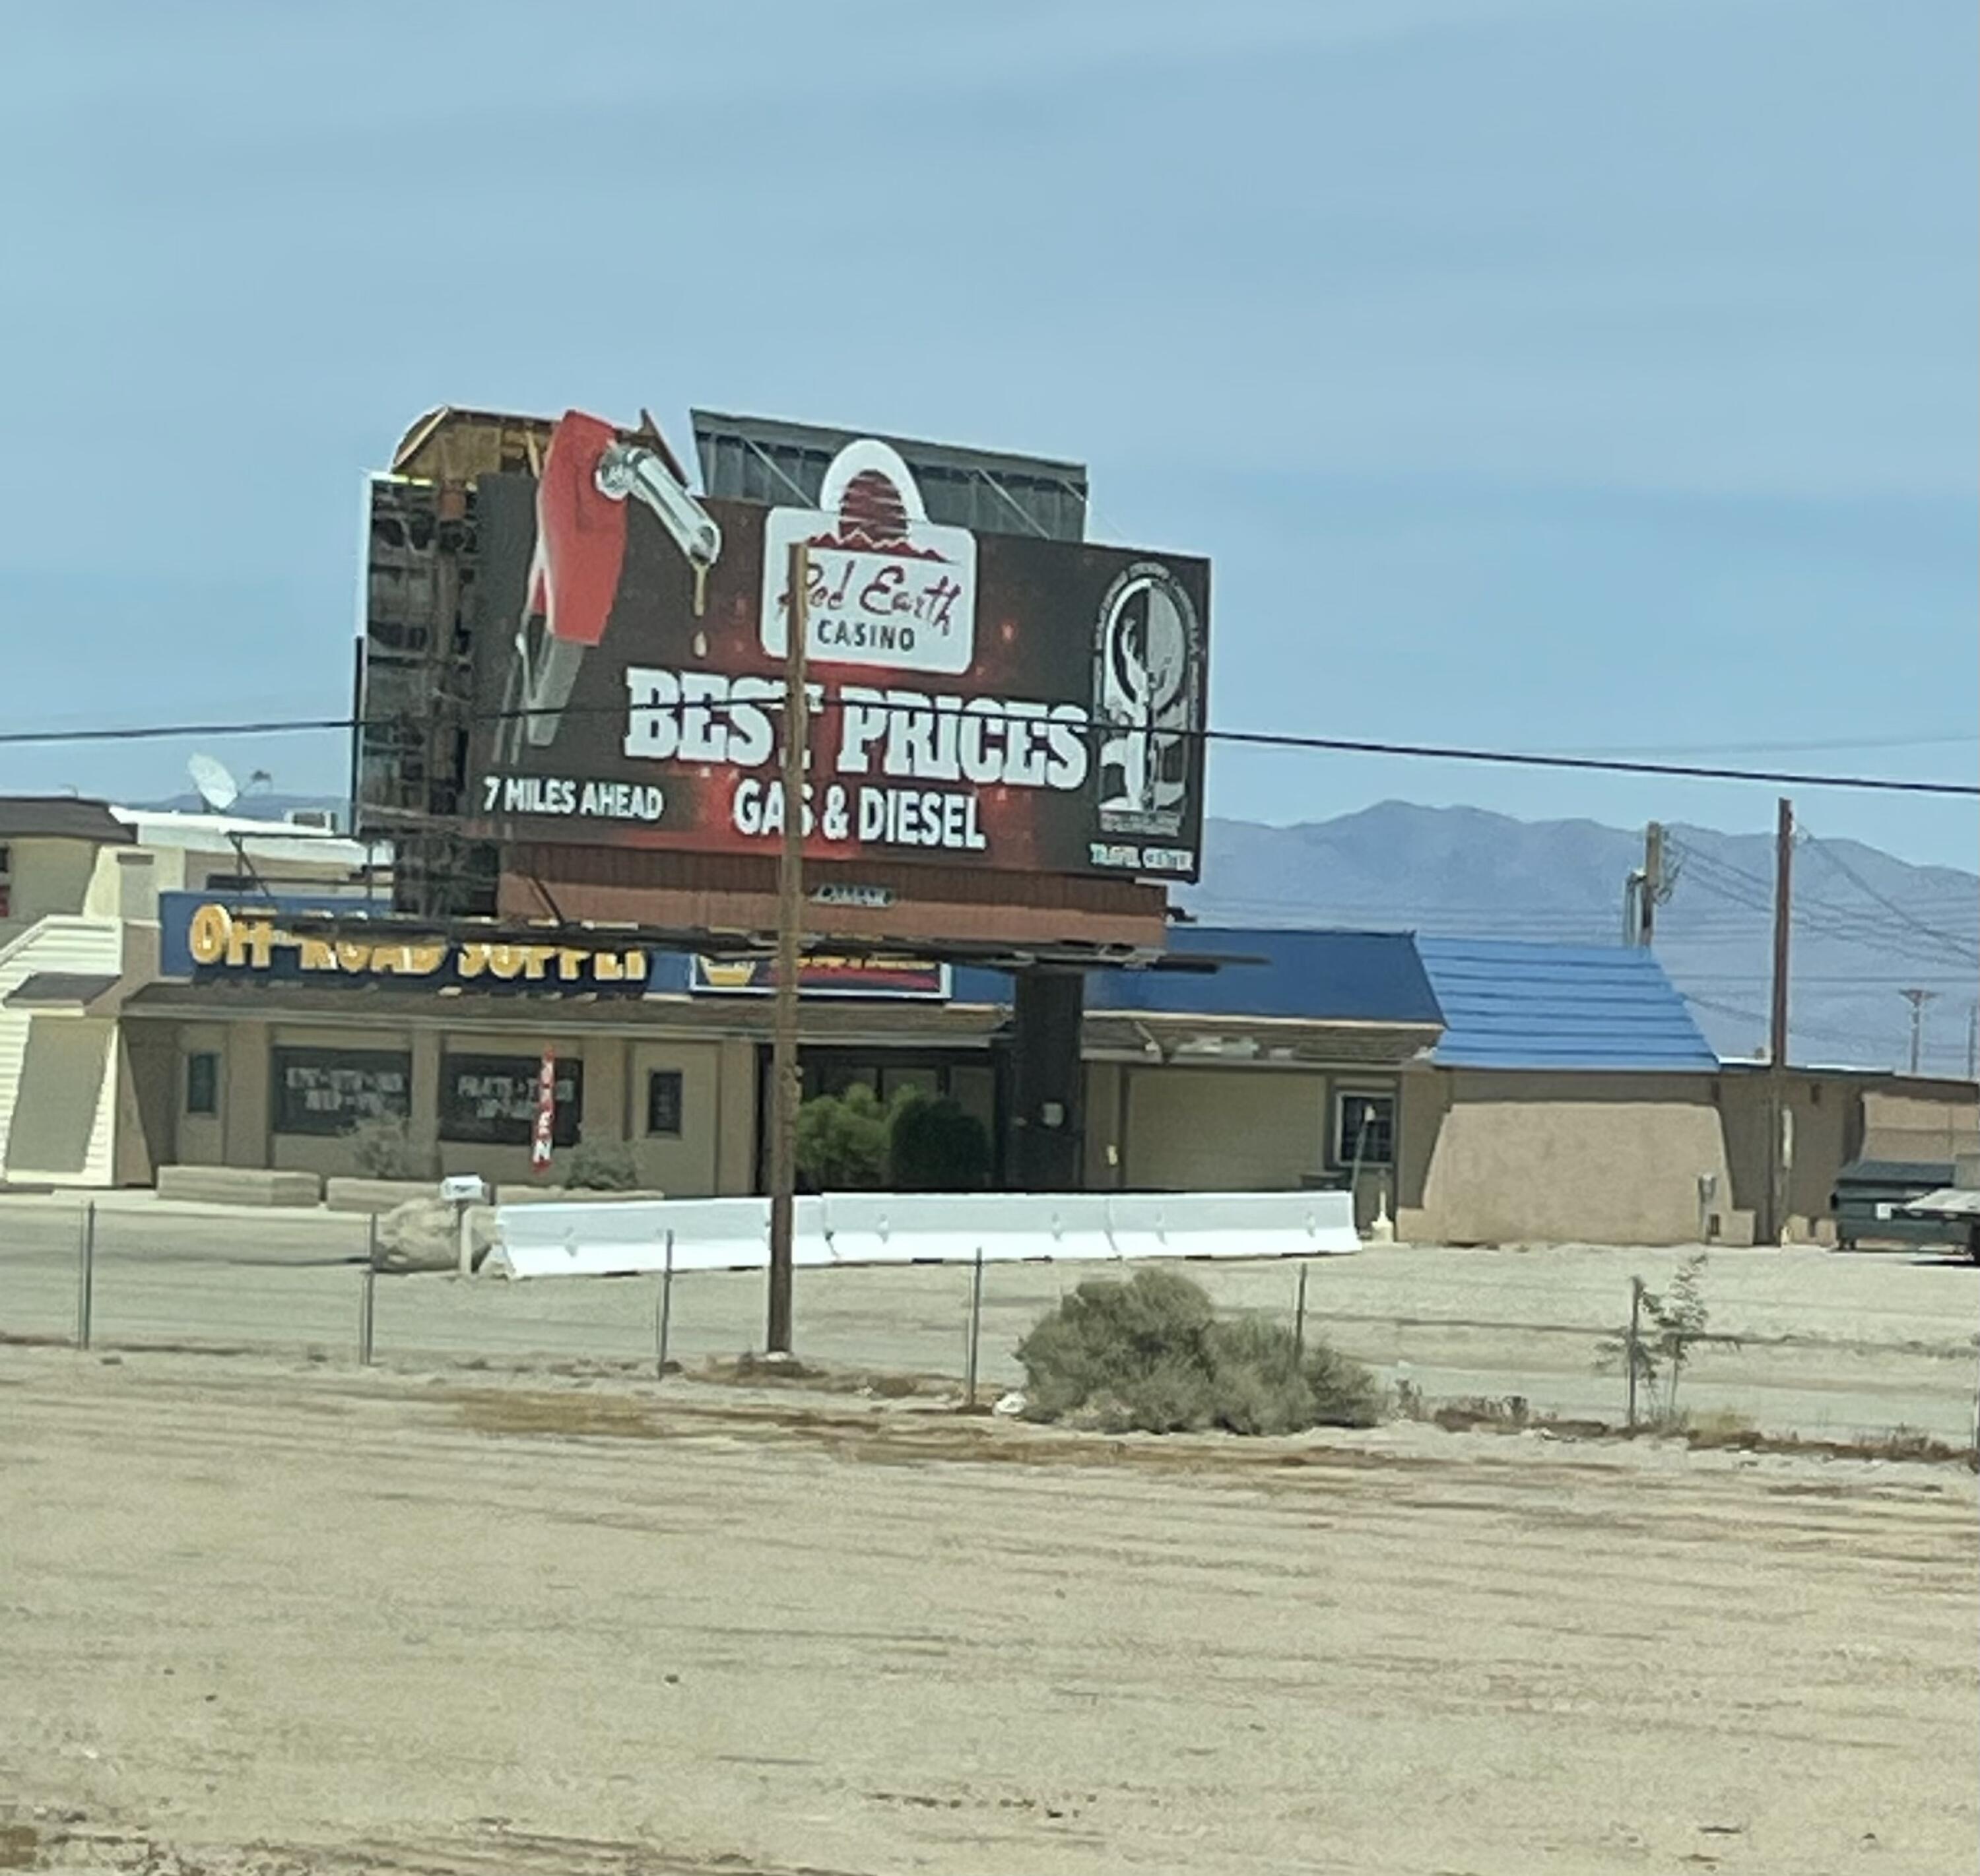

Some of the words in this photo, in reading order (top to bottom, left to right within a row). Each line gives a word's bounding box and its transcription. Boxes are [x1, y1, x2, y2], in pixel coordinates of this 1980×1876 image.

[776, 560, 855, 620] Red
[859, 566, 962, 636] Earth
[817, 620, 915, 651] CASINO
[624, 668, 824, 767] BEST
[837, 686, 1089, 790] PRICES
[484, 776, 501, 812] 7
[504, 778, 576, 814] MILES
[579, 781, 664, 820] AHEAD
[733, 778, 814, 835] GAS
[822, 785, 849, 840] &
[859, 787, 985, 849] DIESEL
